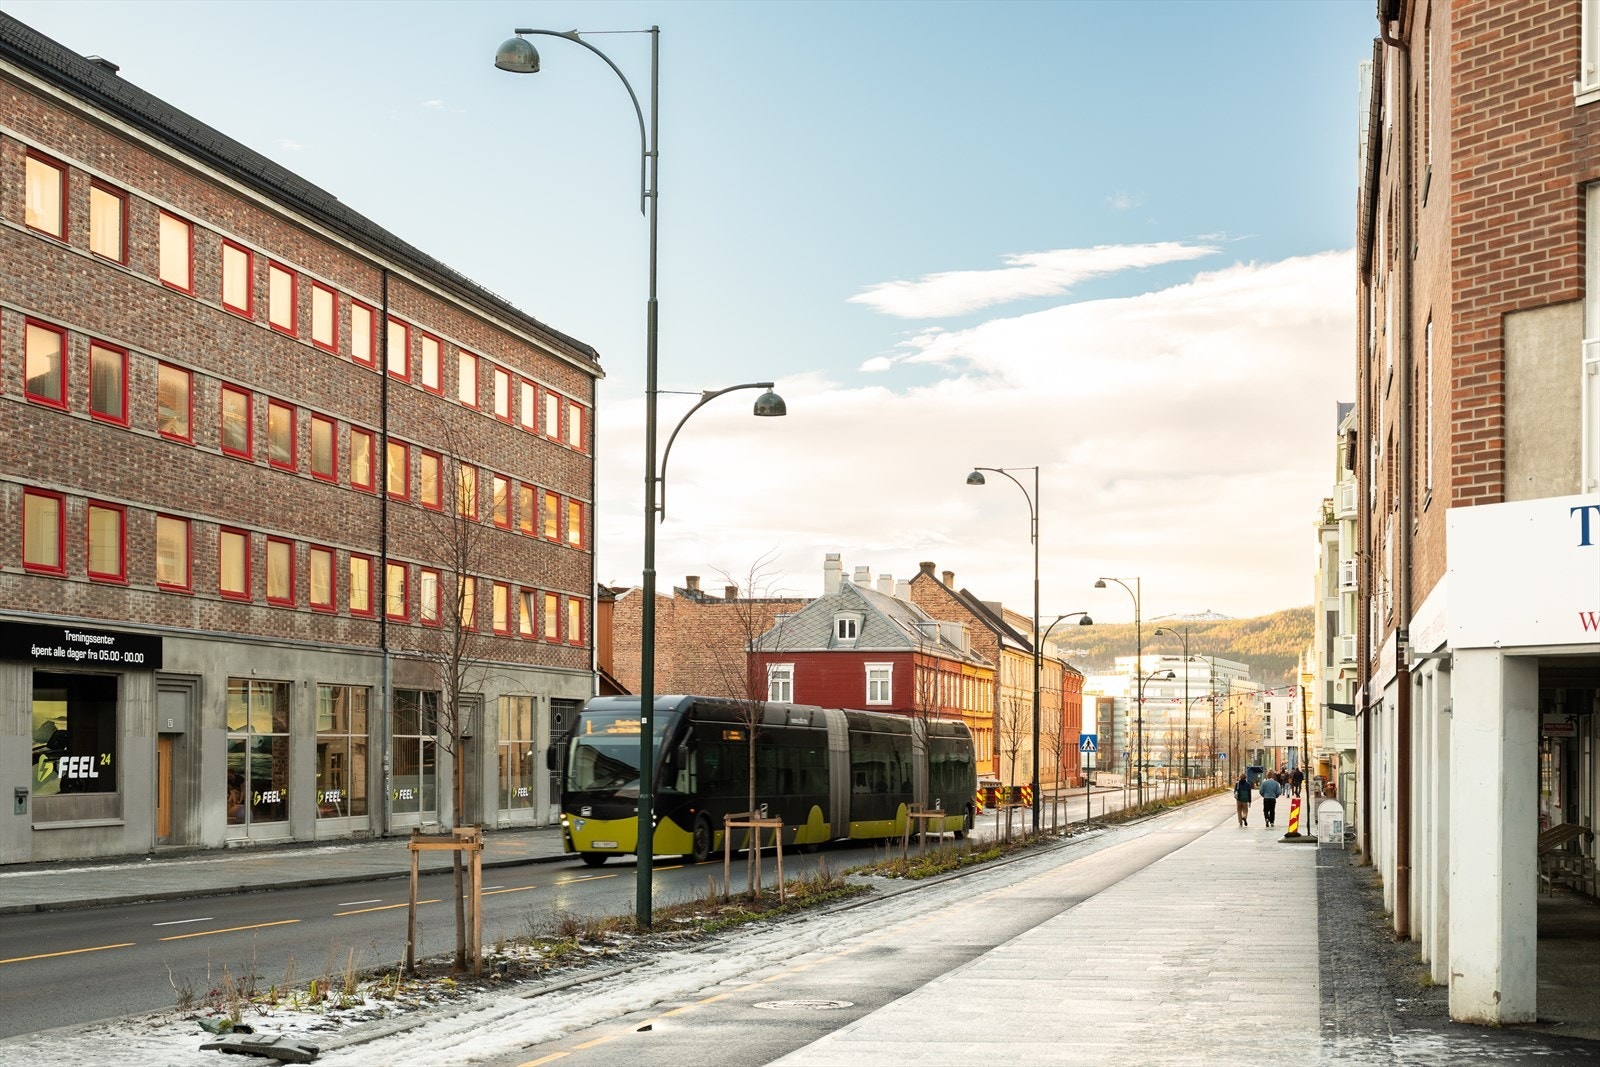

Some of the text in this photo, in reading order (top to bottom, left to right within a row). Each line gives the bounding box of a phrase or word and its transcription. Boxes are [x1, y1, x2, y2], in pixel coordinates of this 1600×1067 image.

[64, 630, 115, 645] Treningssenter
[31, 644, 52, 657] åpent
[53, 646, 66, 657] alle
[67, 647, 86, 661] dager
[88, 649, 98, 660] fra
[99, 650, 120, 661] 05.00
[124, 652, 144, 663] 00.00
[58, 753, 111, 778] FEEL 24
[262, 790, 280, 803] FEEL
[325, 789, 341, 803] FEEL
[399, 789, 414, 800] FEEL
[517, 787, 529, 797] FEEL
